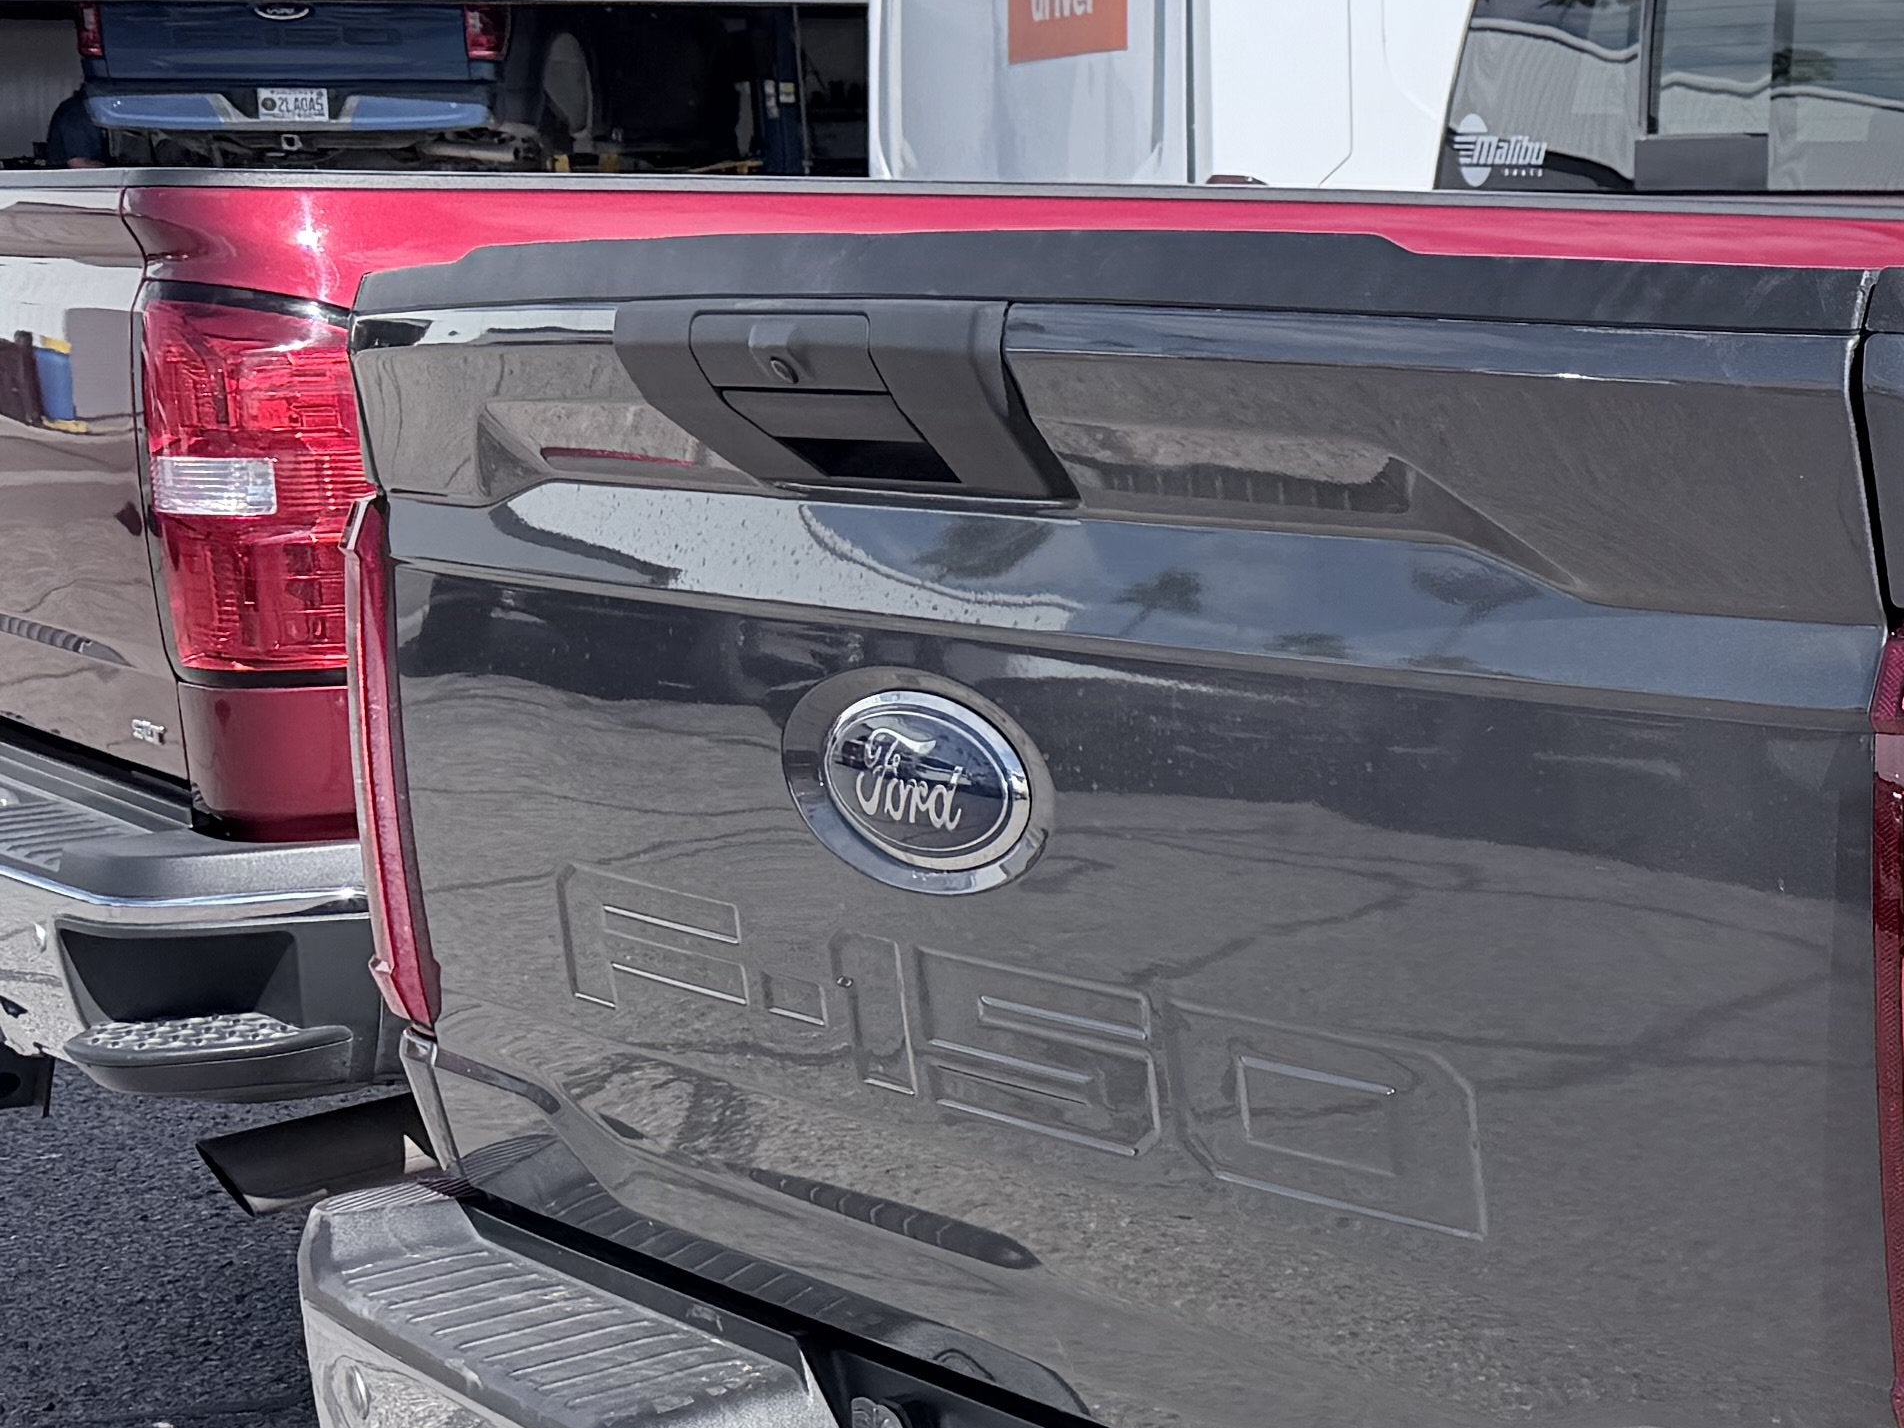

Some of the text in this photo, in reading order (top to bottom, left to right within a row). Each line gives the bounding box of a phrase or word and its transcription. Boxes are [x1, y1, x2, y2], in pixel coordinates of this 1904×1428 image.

[1471, 135, 1548, 165] Malibu
[855, 727, 962, 831] Ford
[557, 862, 1488, 1241] F-150
